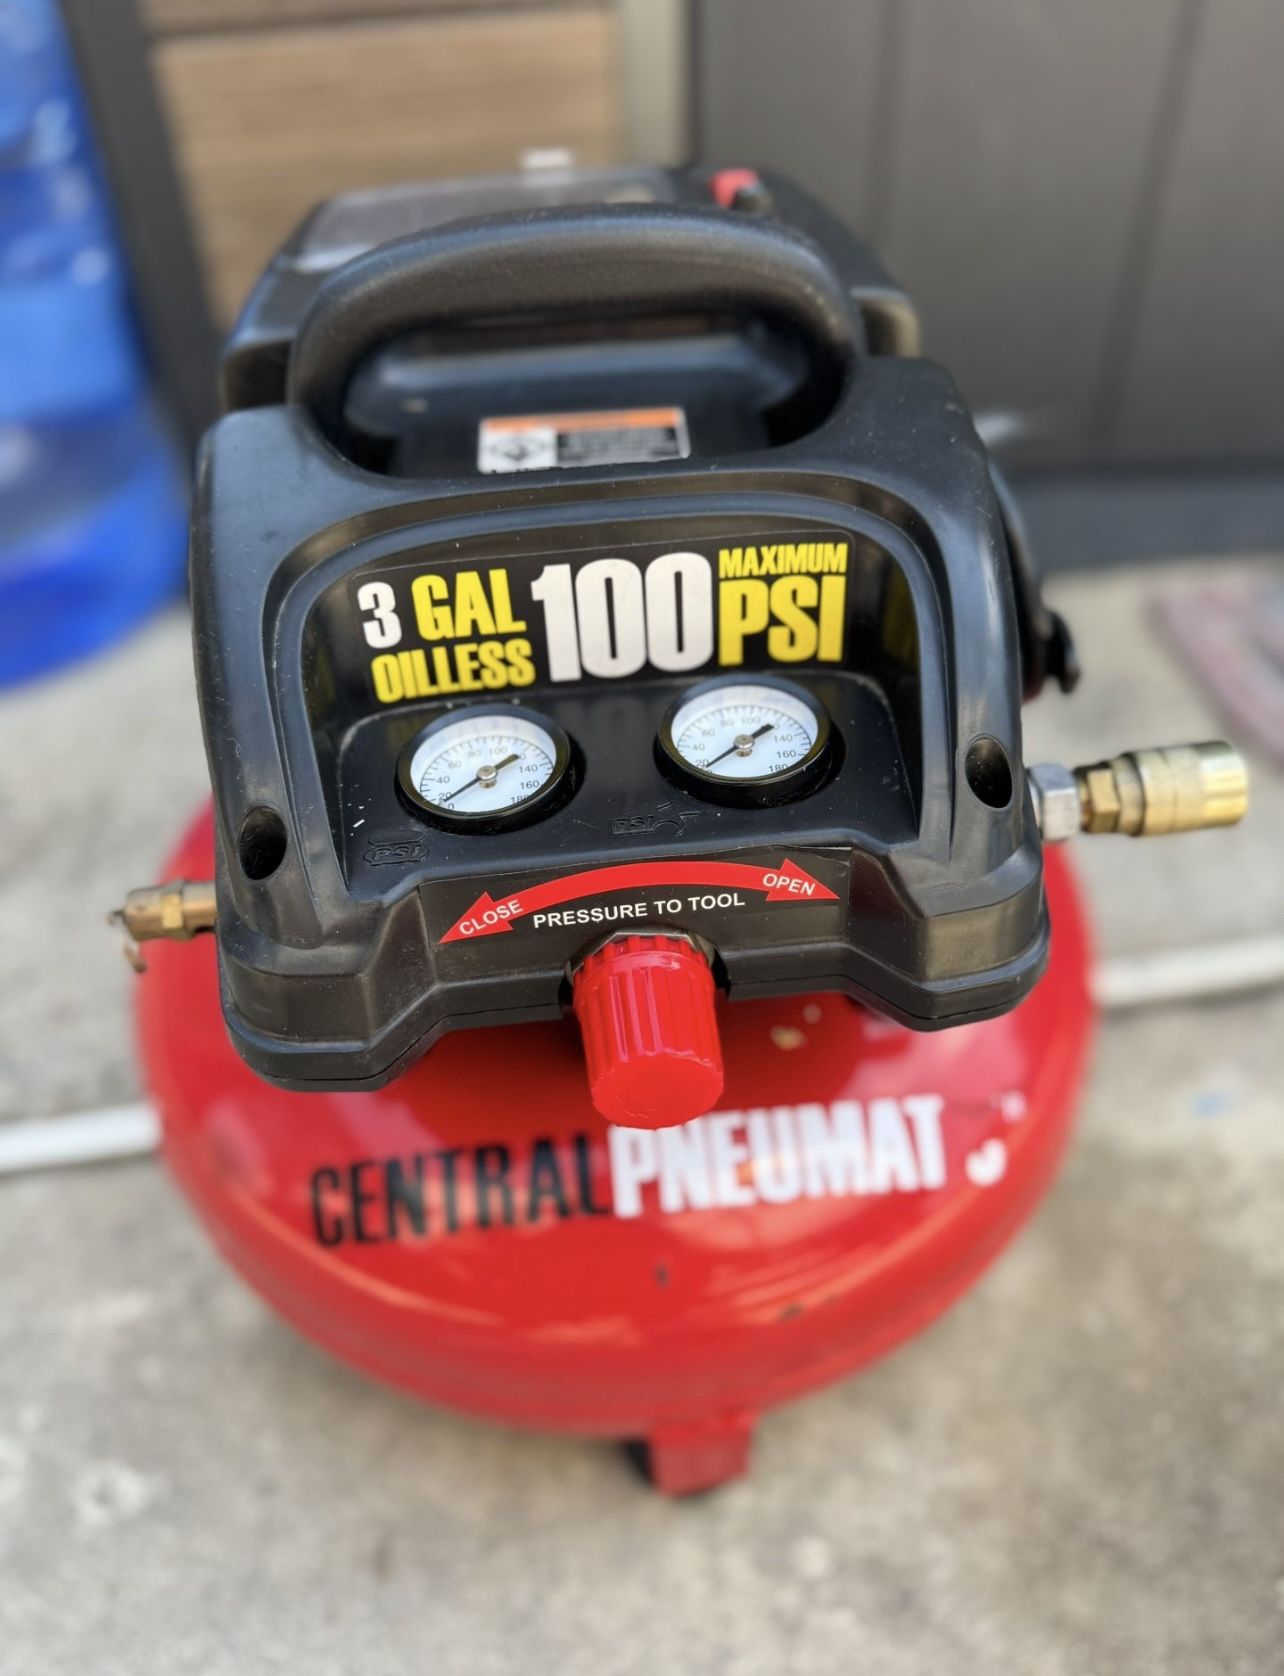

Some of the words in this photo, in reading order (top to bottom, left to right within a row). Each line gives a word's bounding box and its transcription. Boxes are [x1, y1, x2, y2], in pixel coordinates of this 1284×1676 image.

[718, 542, 848, 579] MAXIMUM
[357, 581, 402, 649] 3
[411, 568, 527, 641] GAL
[531, 551, 714, 683] 100
[718, 574, 847, 667] PSI
[371, 638, 536, 704] OILLESS
[489, 746, 508, 755] 100
[692, 743, 706, 751] 40
[774, 734, 793, 743] 140
[777, 750, 797, 759] 160
[437, 776, 450, 784] 40
[519, 764, 538, 774] 140
[439, 791, 453, 802] 20
[520, 780, 540, 790] 160
[762, 872, 816, 897] OPEN
[459, 899, 524, 936] CLOSE
[533, 902, 648, 929] PRESSURE
[654, 899, 682, 915] TO
[687, 892, 745, 912] TOOL
[311, 1130, 613, 1247] CENTRAL
